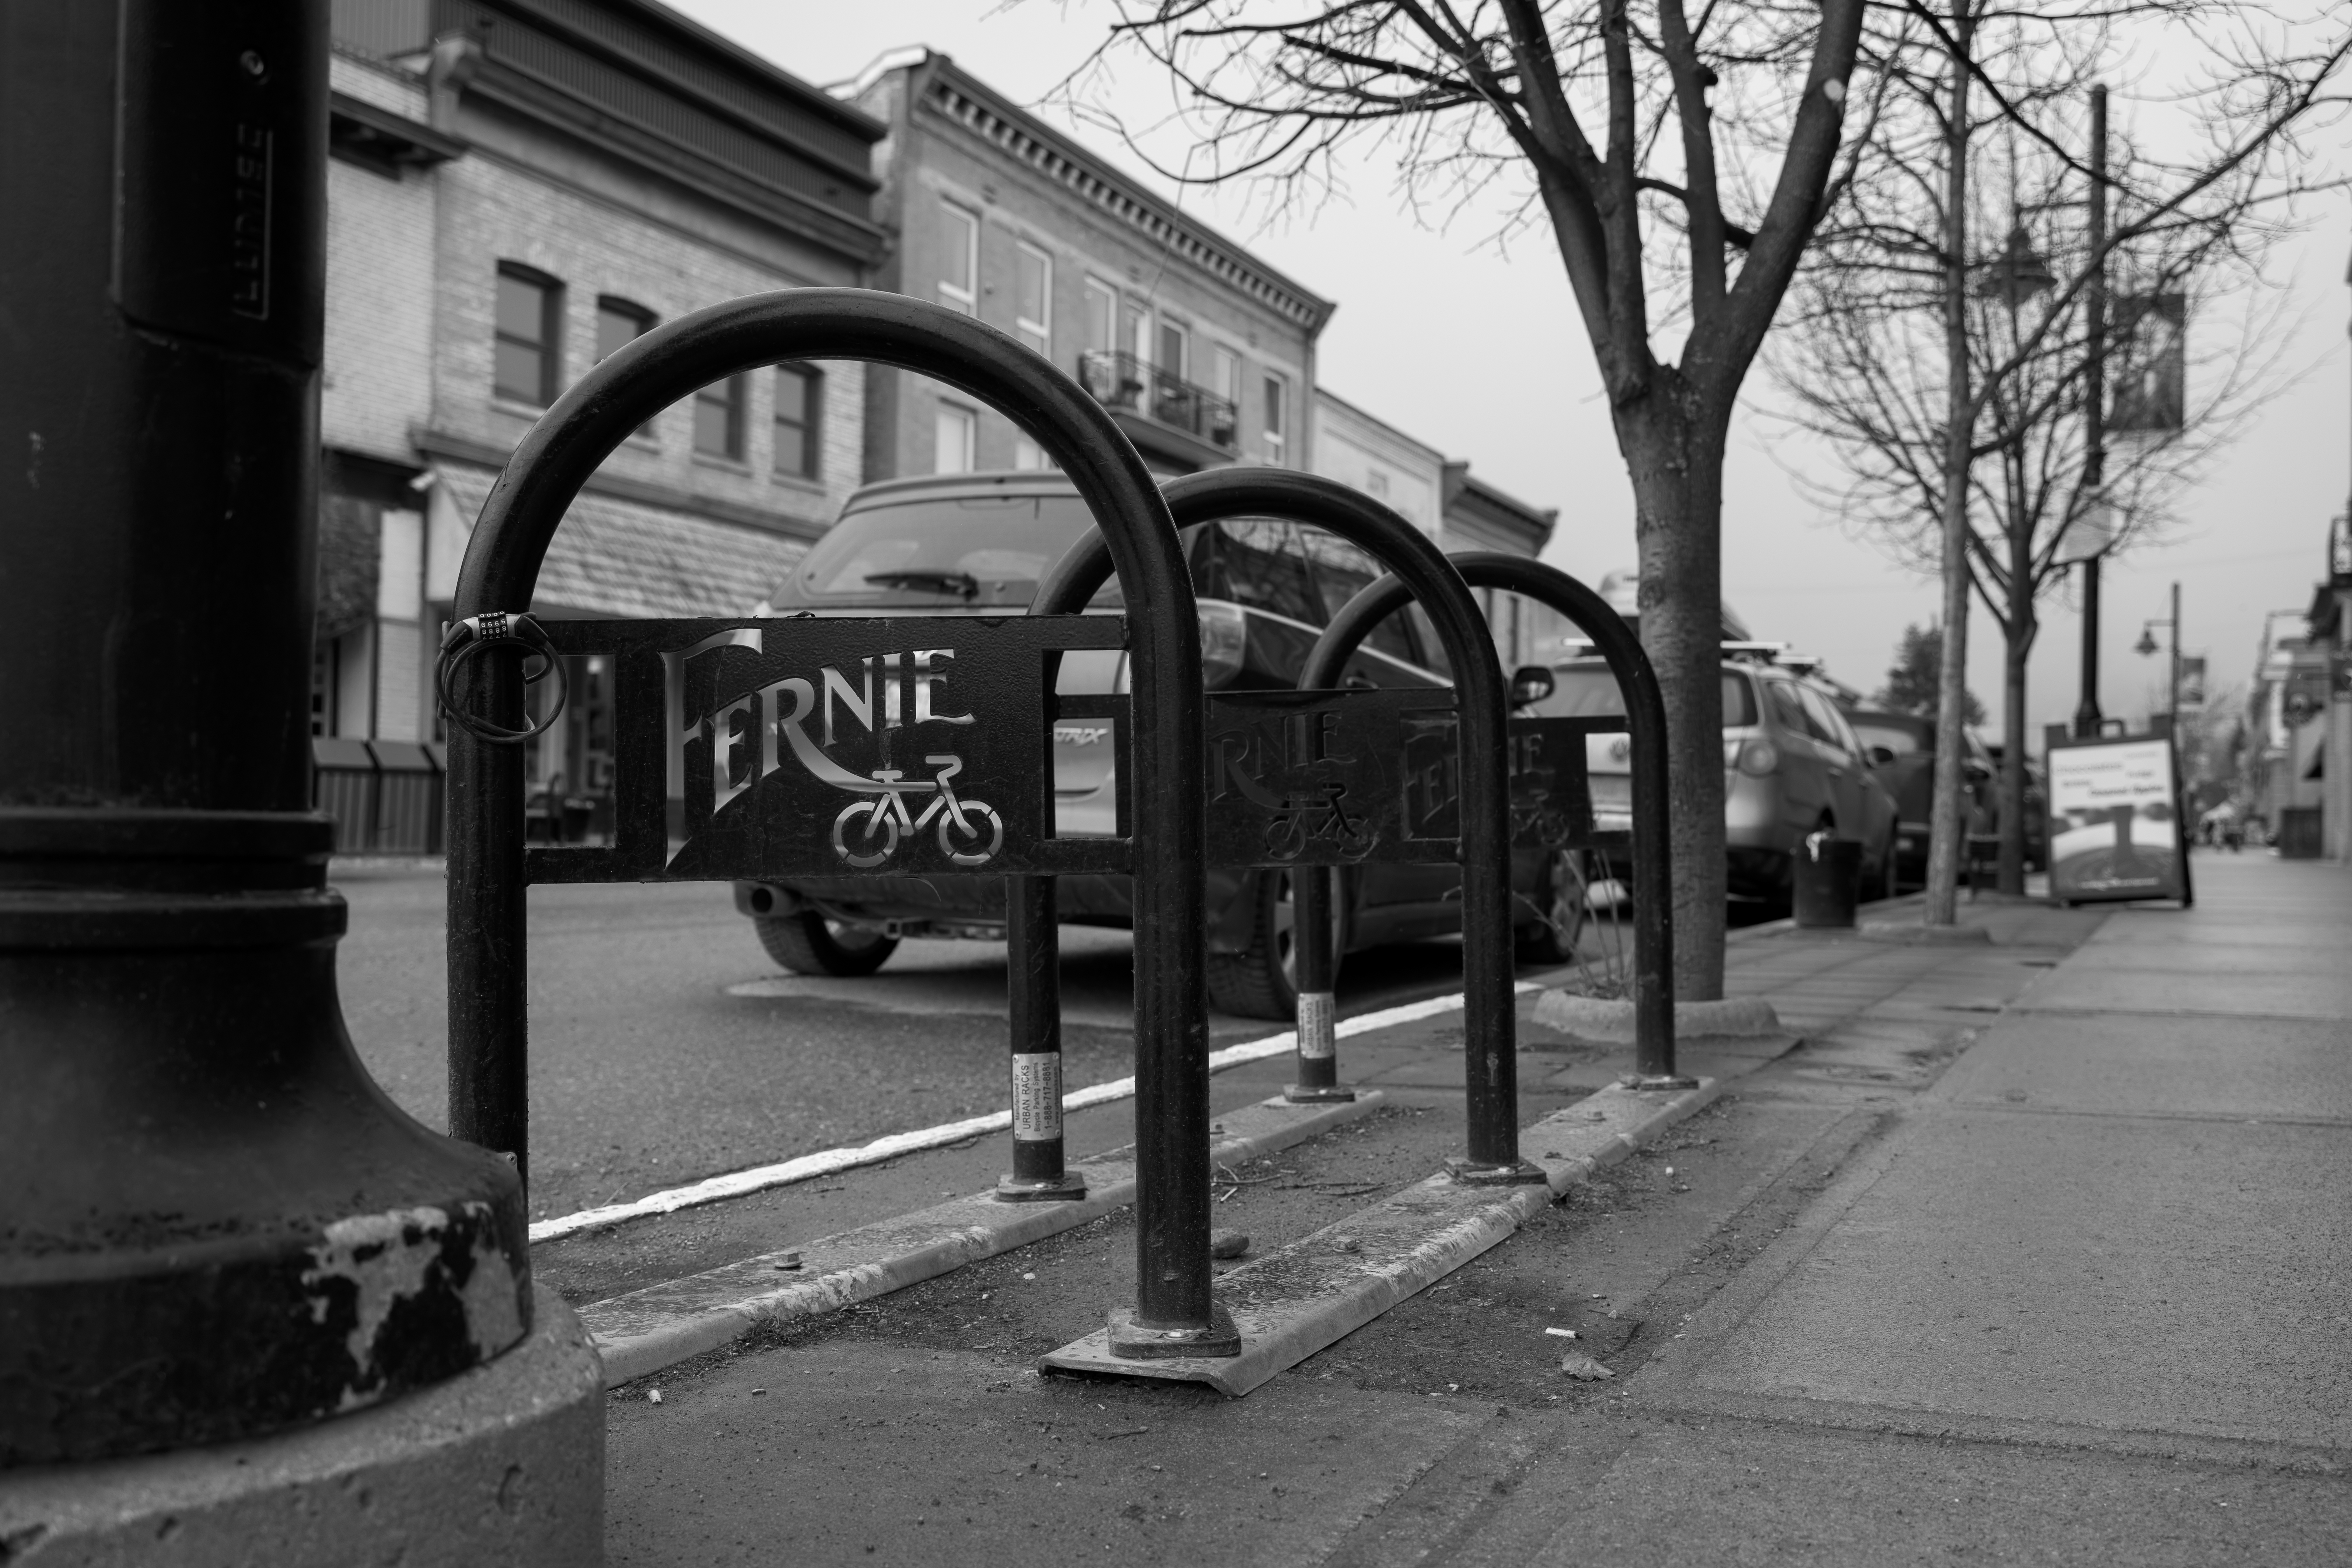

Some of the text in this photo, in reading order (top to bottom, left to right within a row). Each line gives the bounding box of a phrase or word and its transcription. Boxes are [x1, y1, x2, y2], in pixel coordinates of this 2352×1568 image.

[658, 628, 976, 870] FERNIE
[1208, 708, 1357, 810] RNIE
[1021, 1065, 1031, 1129] URBAN RACKS
[1033, 1111, 1041, 1132] Bicycle
[1042, 1062, 1052, 1129] 1-888-717-8881
